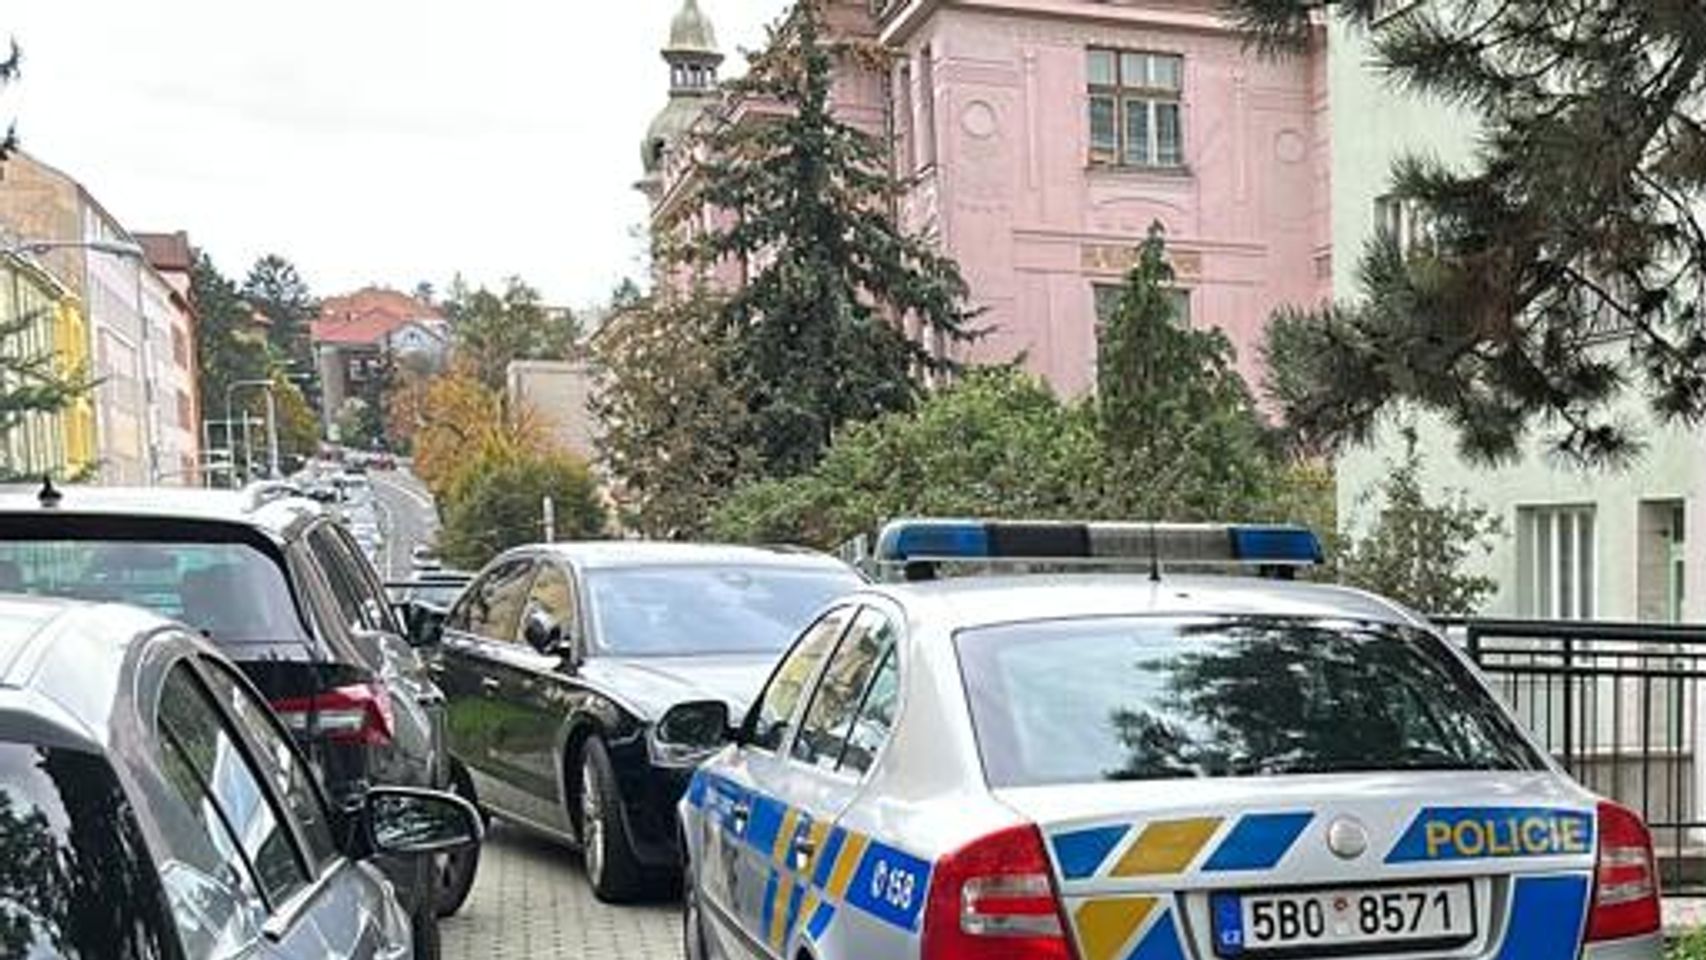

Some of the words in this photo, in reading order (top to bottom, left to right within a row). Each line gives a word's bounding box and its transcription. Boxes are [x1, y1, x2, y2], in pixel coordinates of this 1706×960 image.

[1425, 816, 1585, 857] POLICIE
[1252, 897, 1325, 941] 5B0
[1359, 891, 1451, 935] 8571
